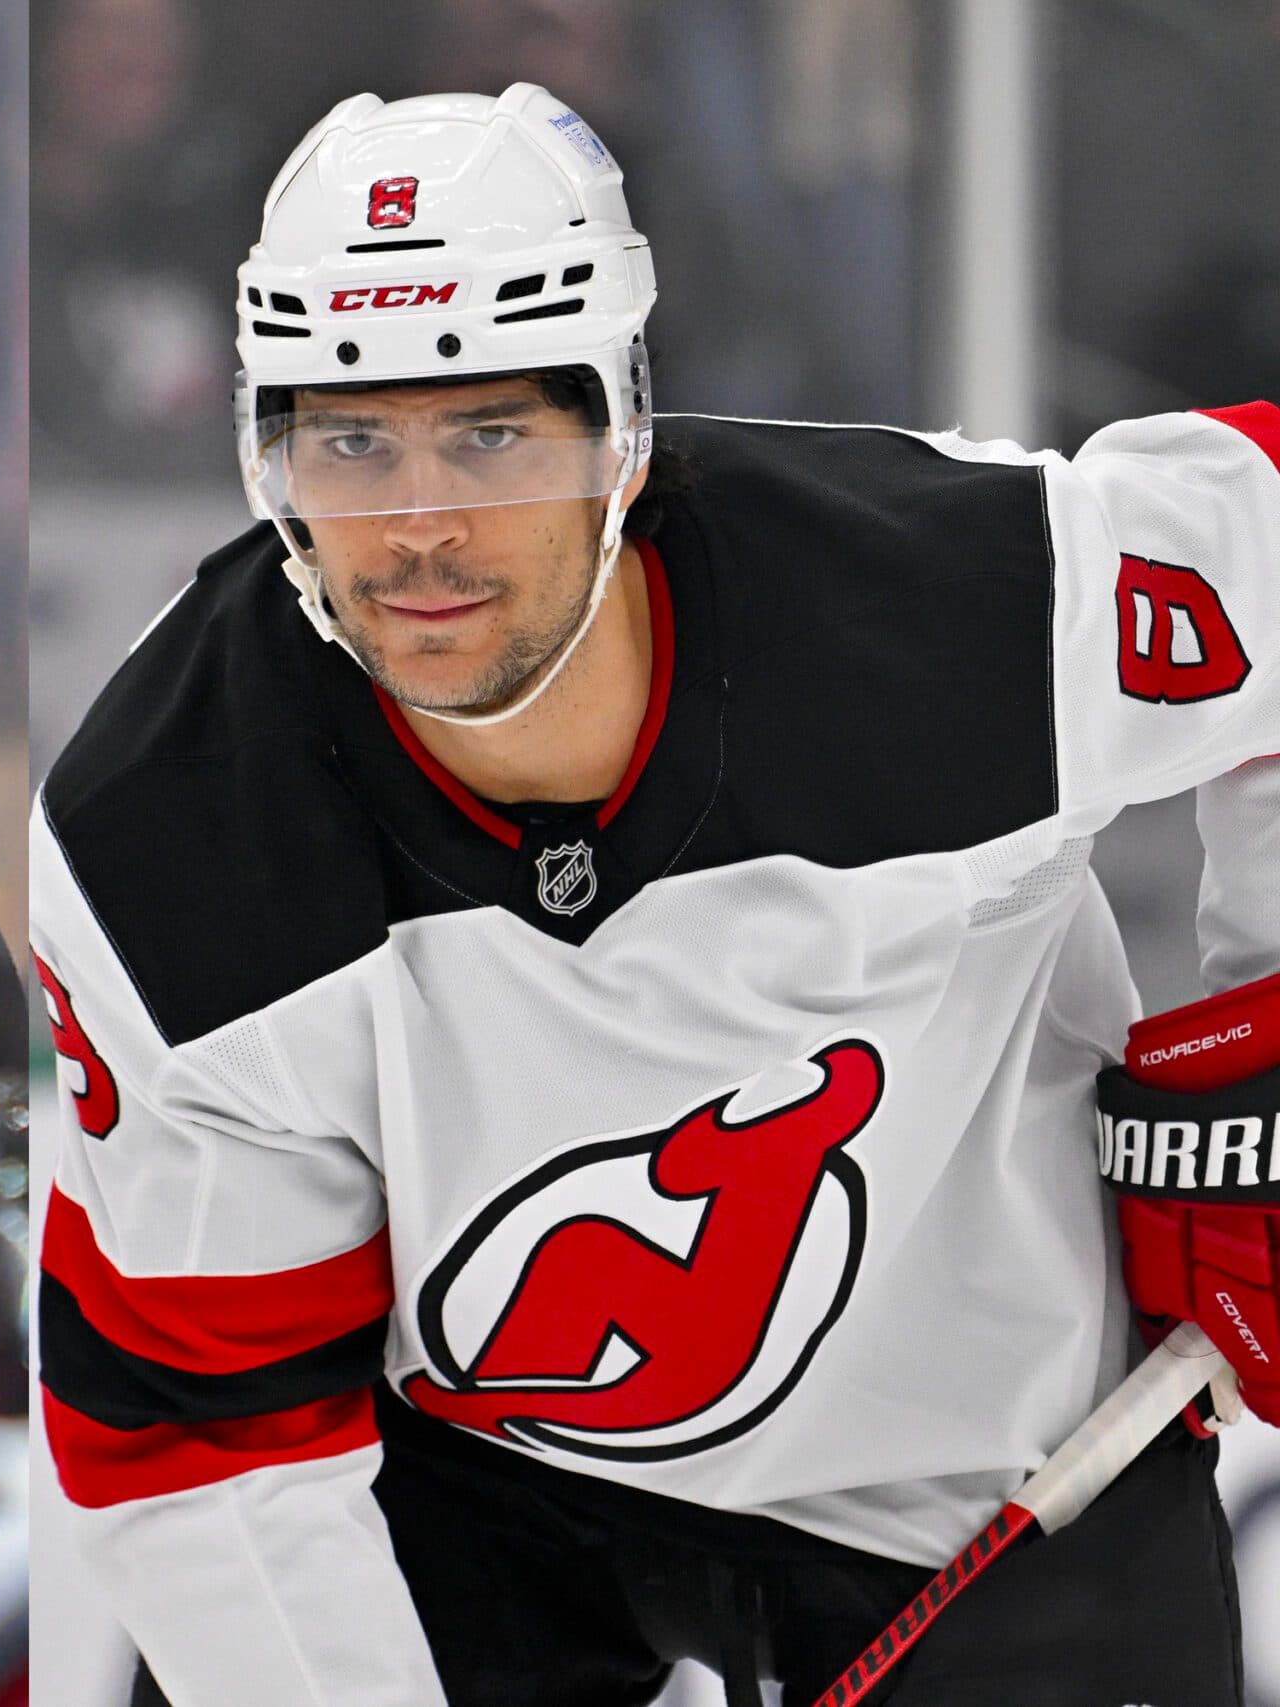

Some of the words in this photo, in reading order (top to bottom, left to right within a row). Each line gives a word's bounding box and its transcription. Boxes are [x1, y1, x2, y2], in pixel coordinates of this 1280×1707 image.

[367, 176, 419, 230] 8
[328, 281, 459, 313] CCM
[1115, 551, 1253, 705] 8
[552, 860, 583, 902] NHL
[1139, 1022, 1253, 1068] KOVACEVIC
[1215, 1291, 1270, 1364] COVERT
